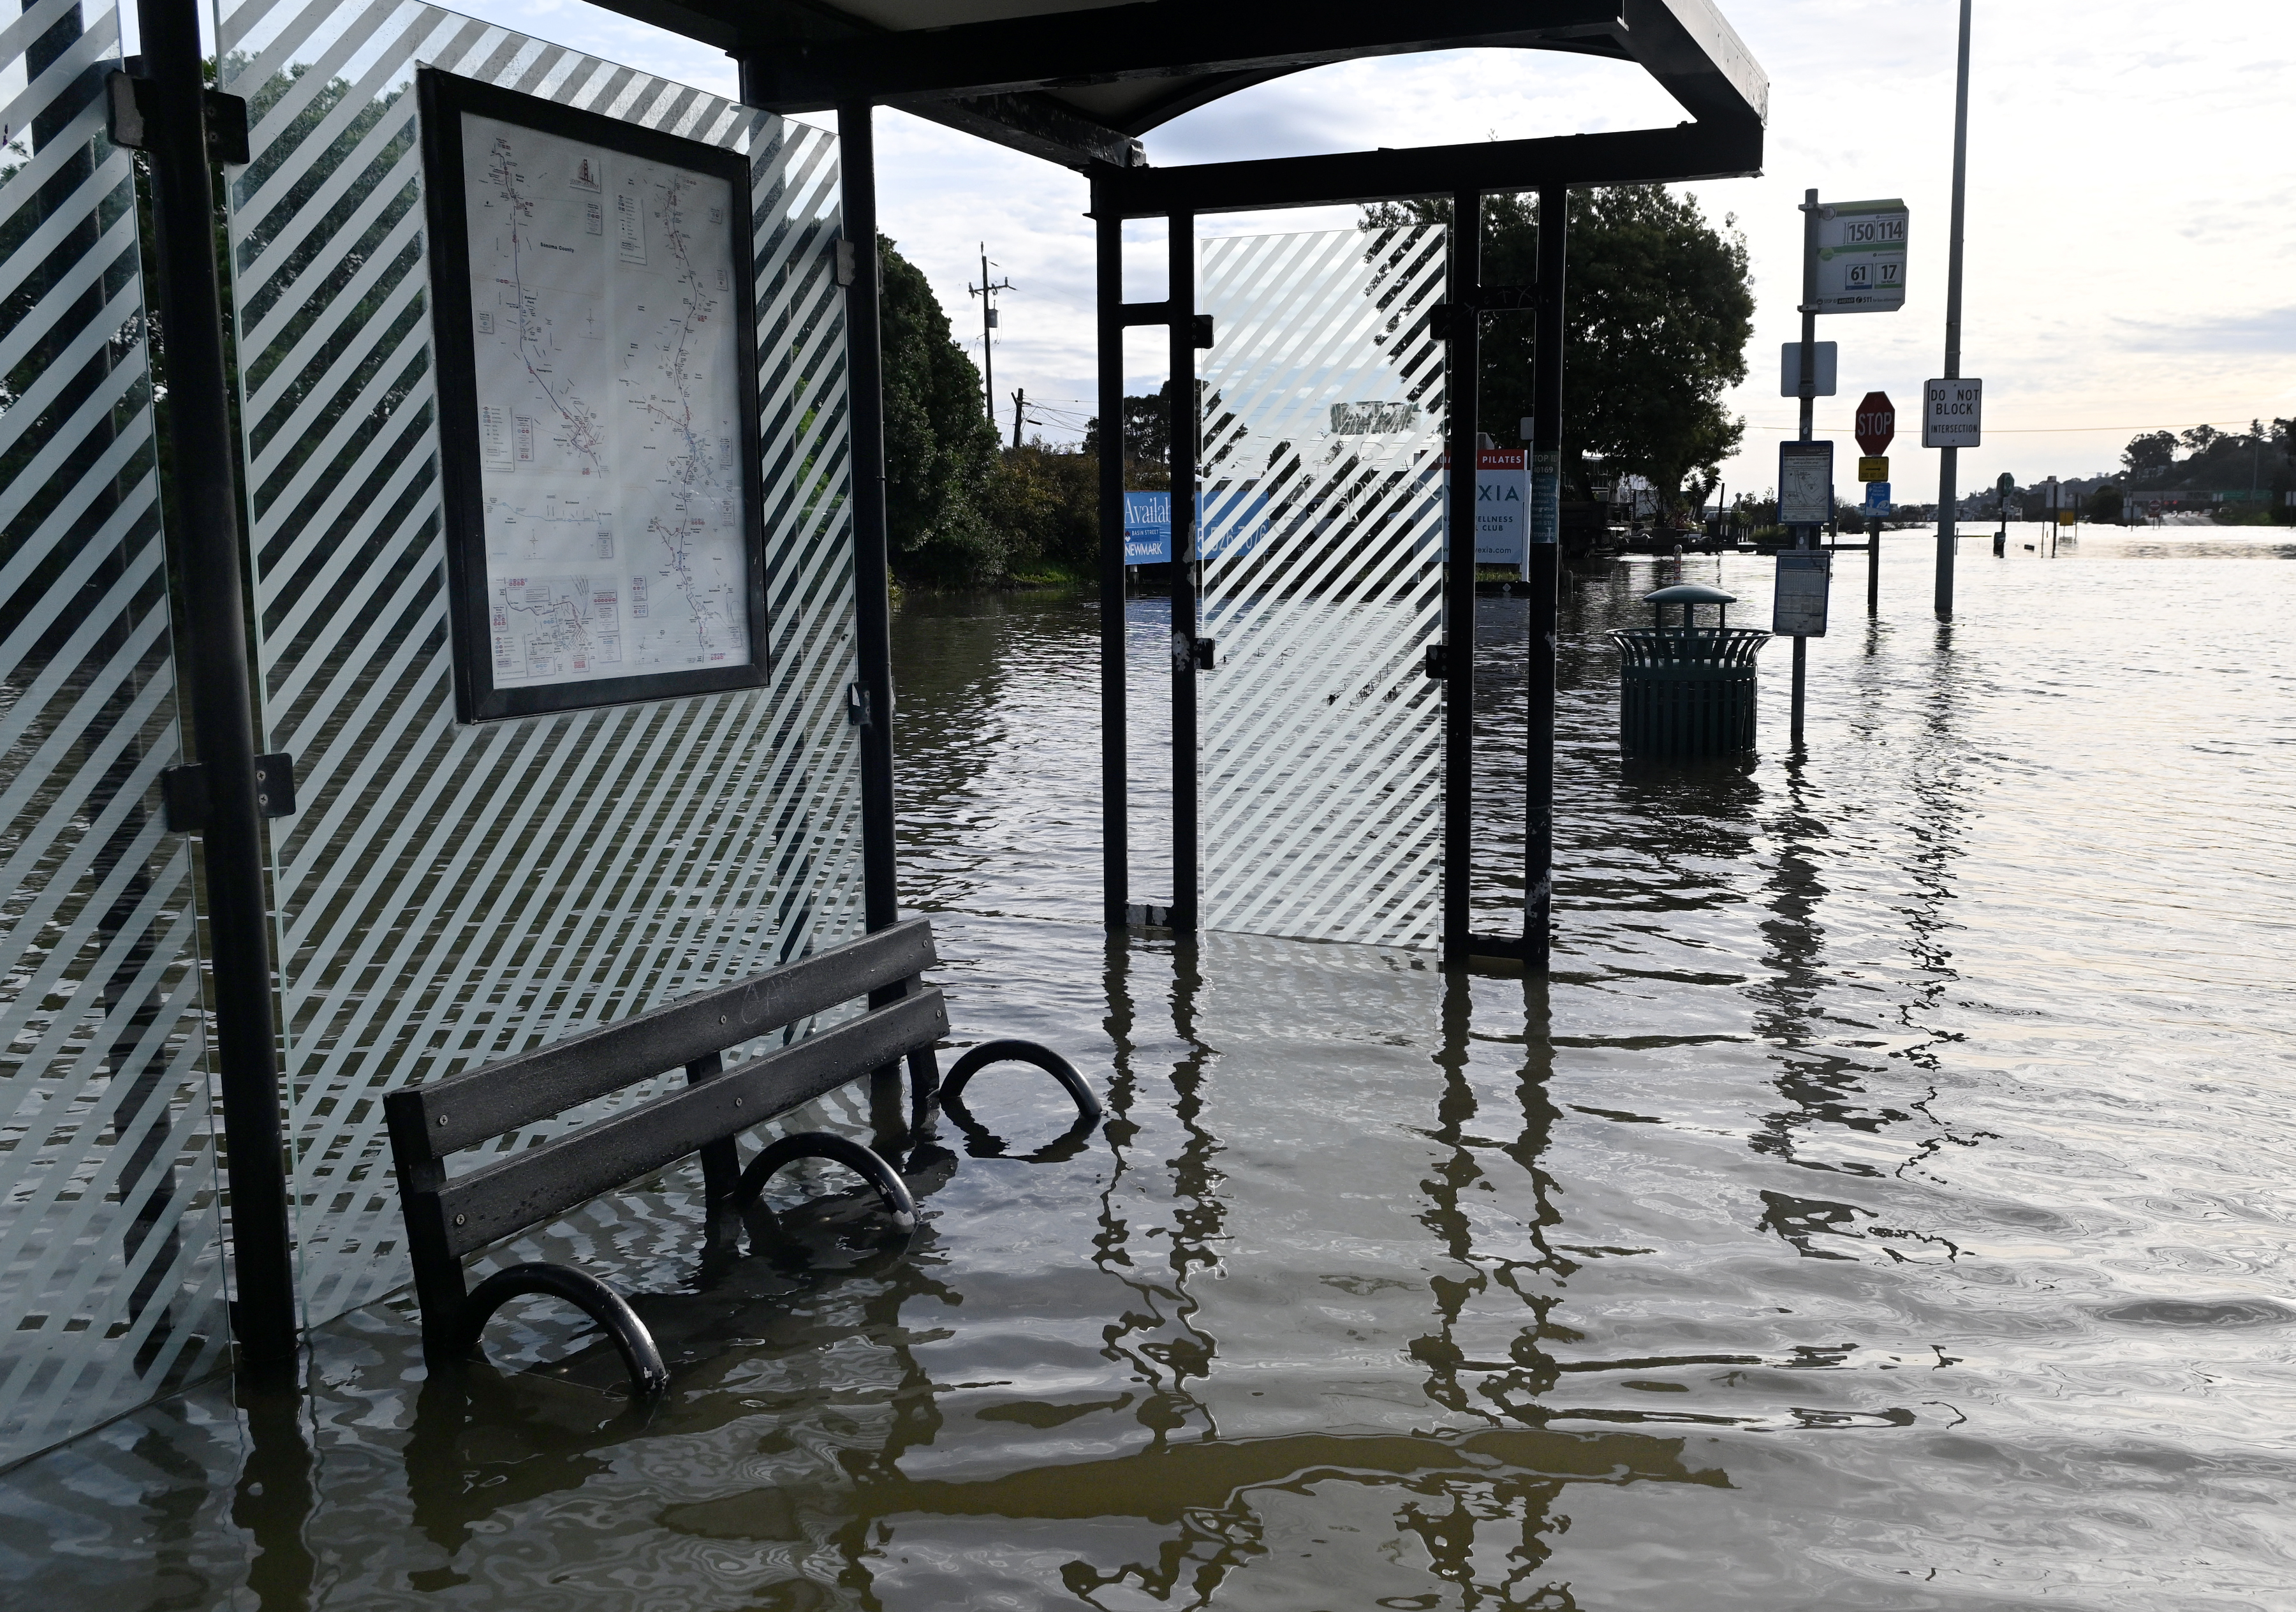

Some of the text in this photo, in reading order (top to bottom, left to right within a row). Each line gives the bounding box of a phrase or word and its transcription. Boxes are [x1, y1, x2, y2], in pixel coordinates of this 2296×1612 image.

[1849, 221, 1902, 242] 150 114
[1851, 265, 1897, 281] 61 17
[1931, 389, 1980, 401] DO NOT
[1936, 403, 1973, 415] BLOCK
[1858, 411, 1892, 437] STOP
[1931, 424, 1978, 434] INTERSECTION
[1482, 455, 1522, 464] PILATES
[1533, 454, 1549, 462] TOP
[1124, 496, 1171, 524] Availab
[1124, 542, 1163, 557] NEWMARK
